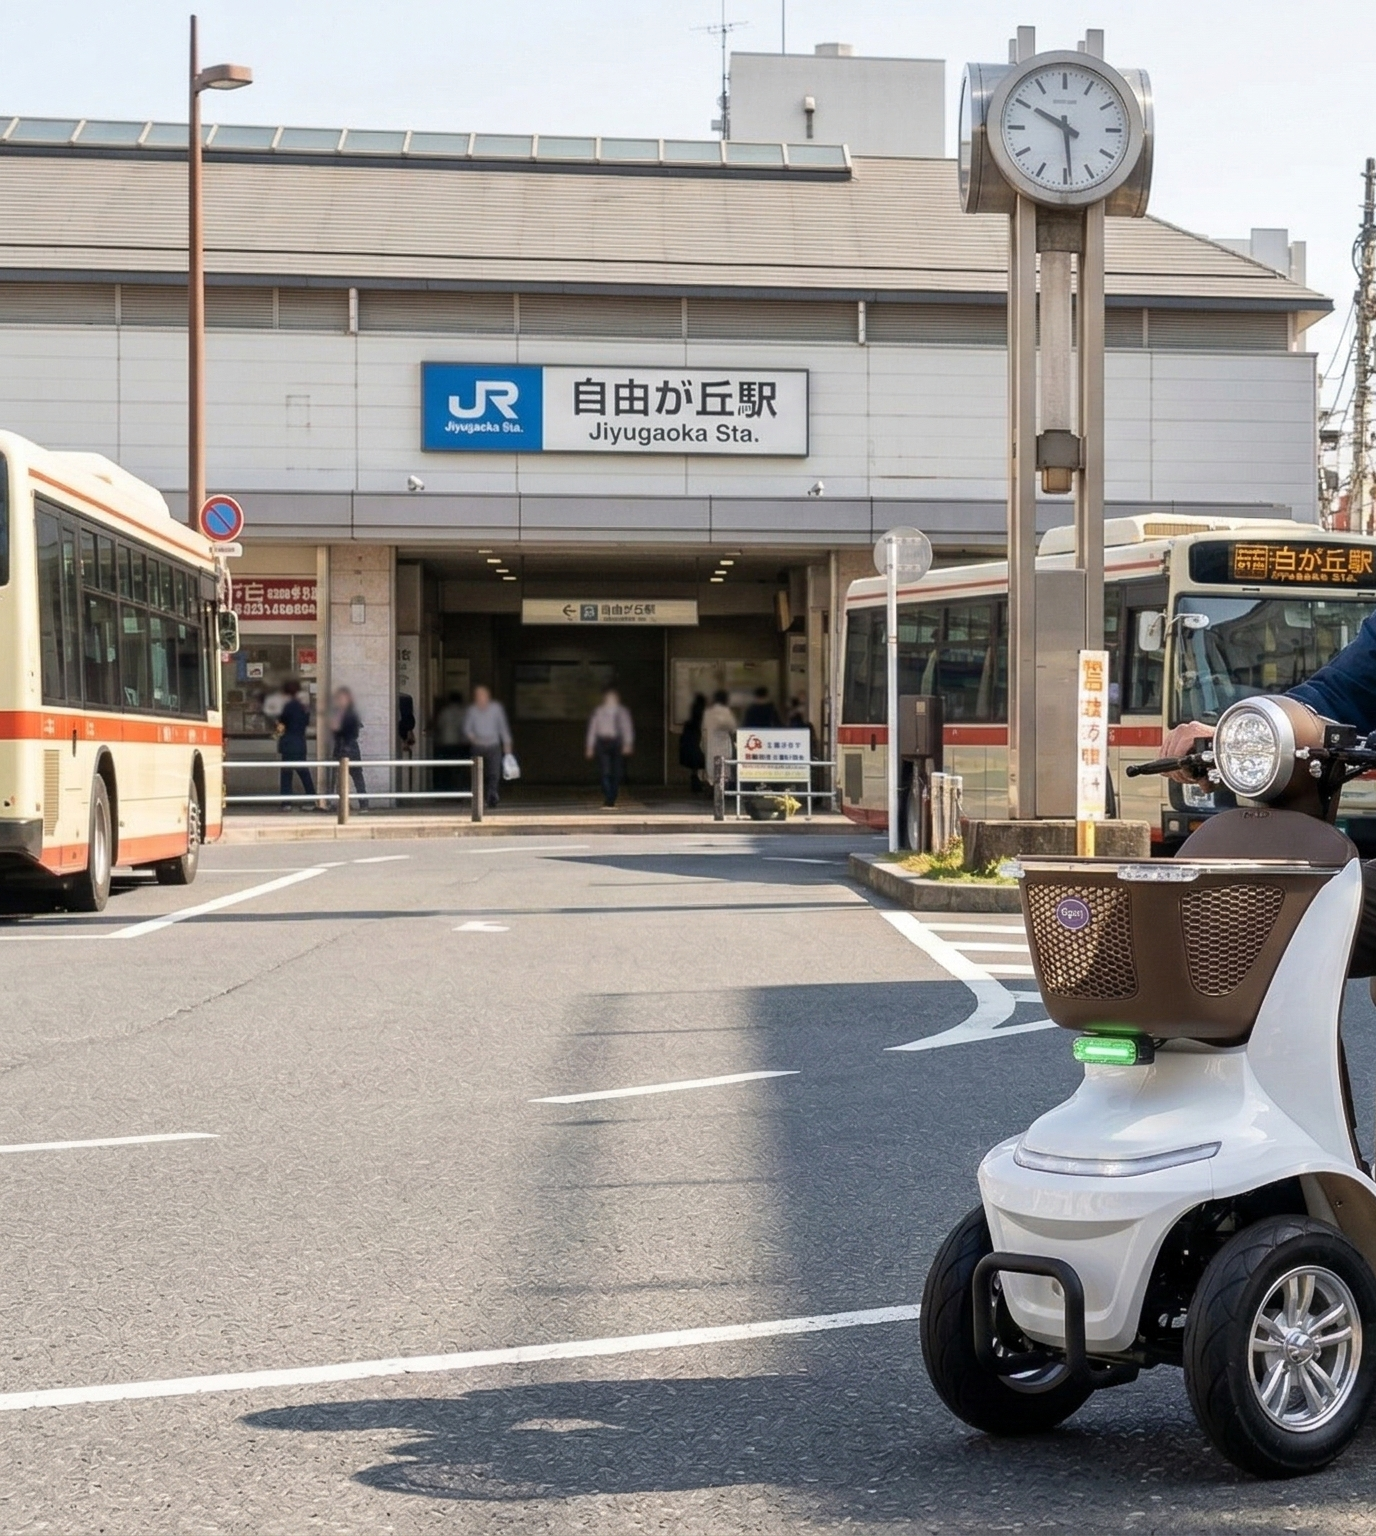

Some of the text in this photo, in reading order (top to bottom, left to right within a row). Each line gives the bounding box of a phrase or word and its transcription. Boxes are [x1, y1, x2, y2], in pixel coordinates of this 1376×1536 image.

[448, 380, 520, 420] JR
[573, 377, 778, 419] 自由が丘駅
[588, 422, 760, 446] Jiyugaoka Sta.
